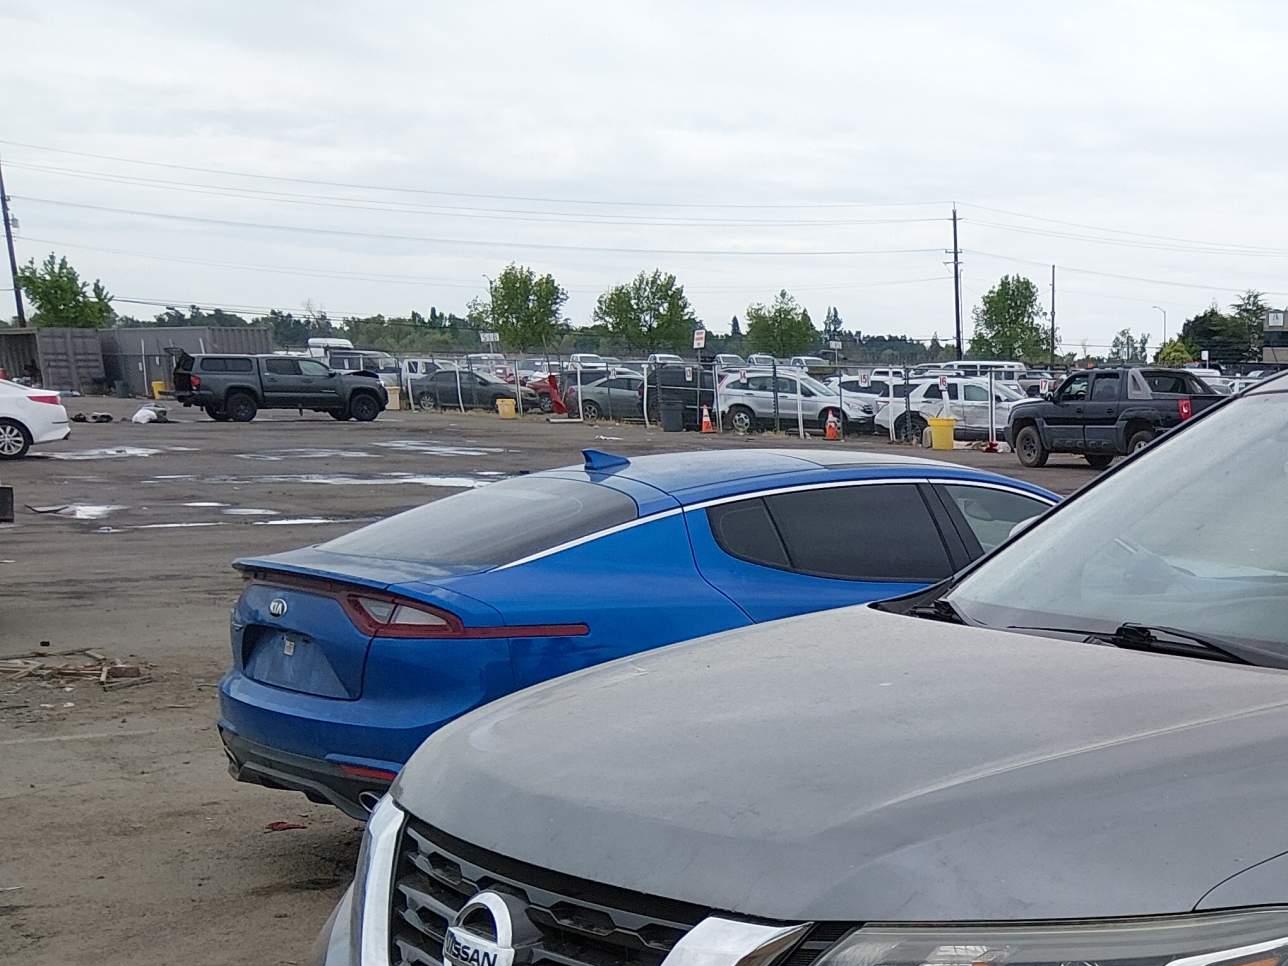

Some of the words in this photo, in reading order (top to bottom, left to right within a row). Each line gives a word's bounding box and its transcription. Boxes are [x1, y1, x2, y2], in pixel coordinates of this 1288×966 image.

[860, 374, 868, 384] 15
[939, 376, 947, 387] 16
[270, 600, 285, 616] KIA
